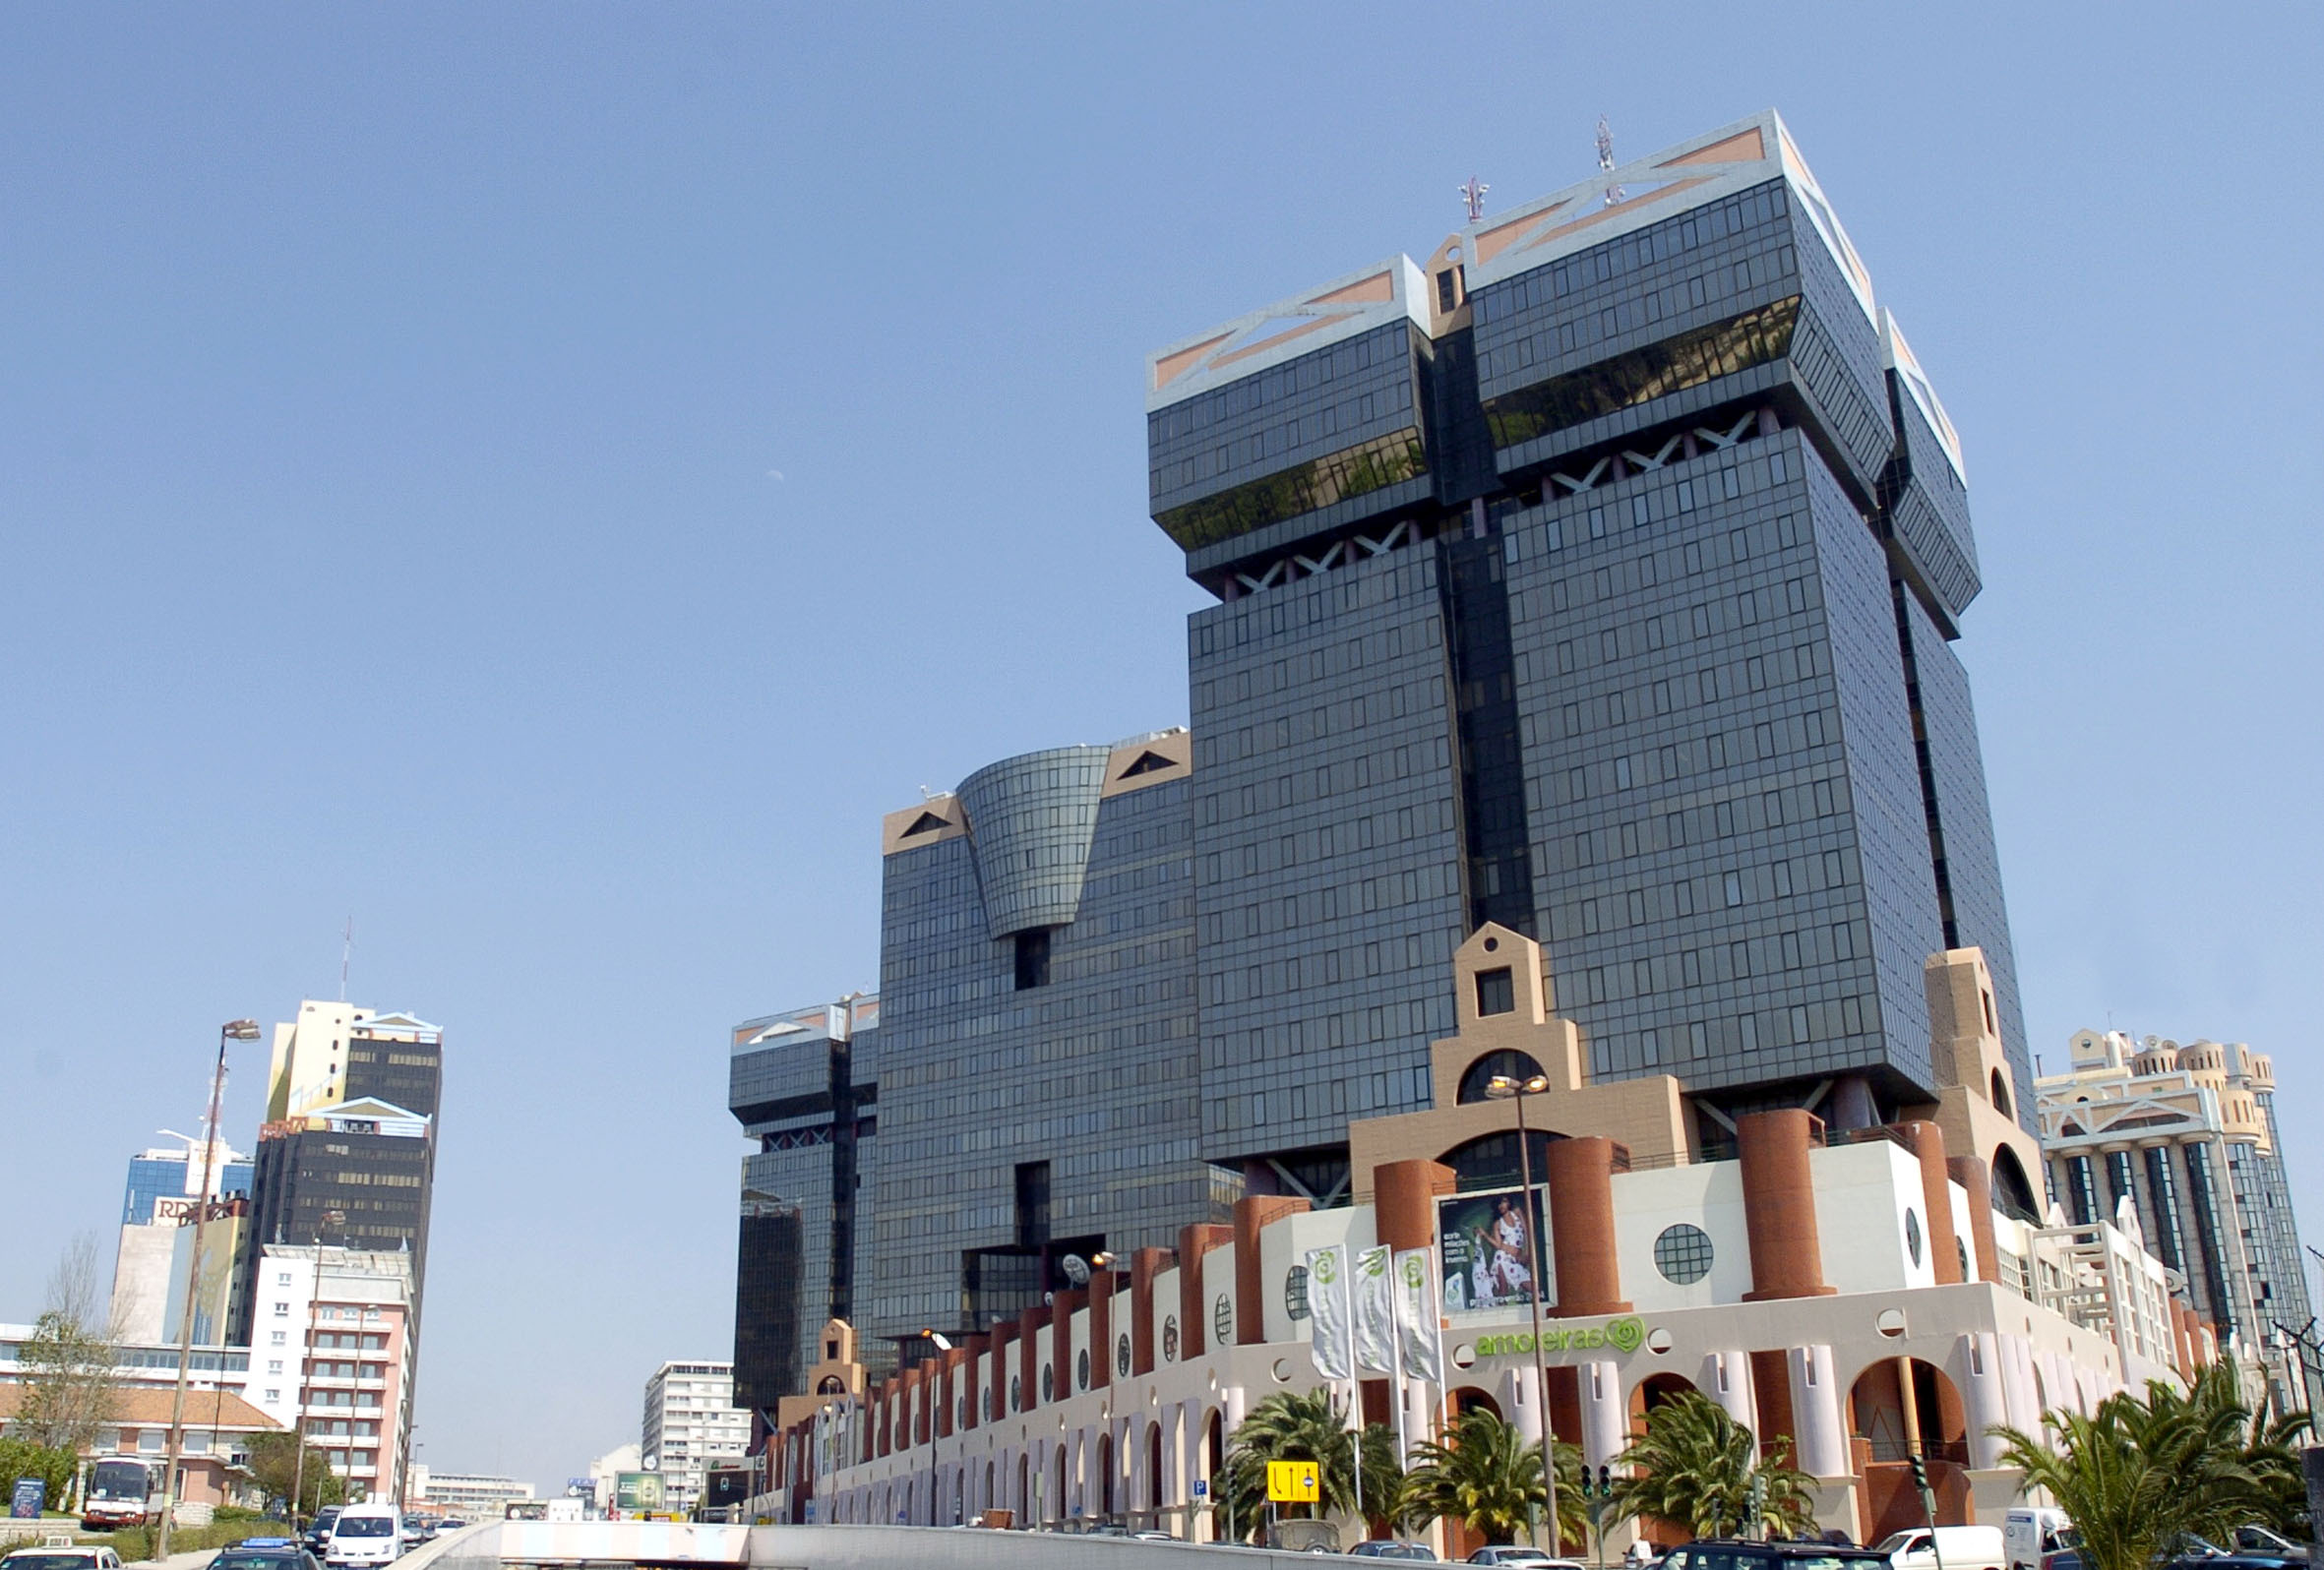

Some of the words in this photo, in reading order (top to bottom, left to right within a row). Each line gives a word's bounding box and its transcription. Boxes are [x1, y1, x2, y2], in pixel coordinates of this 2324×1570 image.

[158, 1200, 202, 1218] RD
[1476, 1324, 1605, 1357] amoeiras
[1196, 1481, 1204, 1493] P
